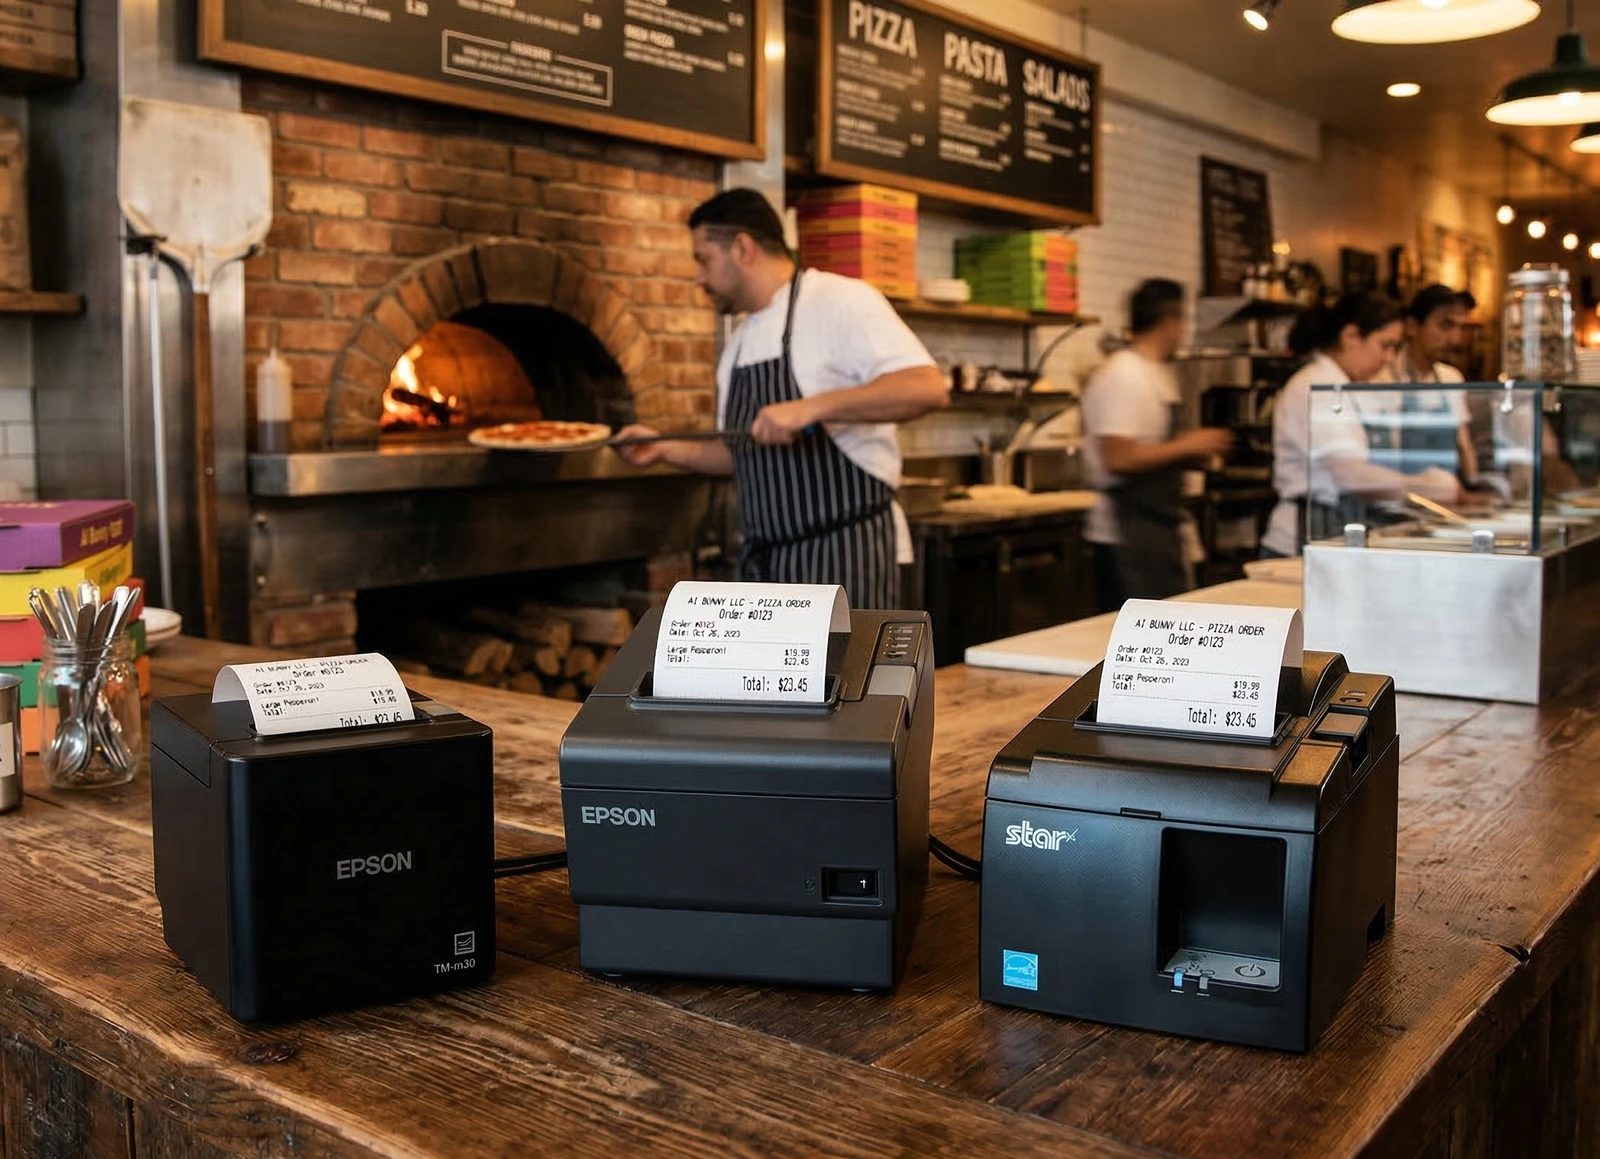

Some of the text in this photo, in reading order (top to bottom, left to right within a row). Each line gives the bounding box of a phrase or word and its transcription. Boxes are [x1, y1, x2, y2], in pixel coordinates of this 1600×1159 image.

[849, 1, 918, 59] PIZZA
[943, 31, 1009, 87] PASTA
[1022, 59, 1092, 113] SALADS
[701, 597, 726, 606] BUNNY
[729, 598, 746, 607] LLC
[757, 598, 782, 608] PIZZA
[785, 599, 811, 608] ORDER
[718, 608, 773, 621] Order #0123
[1135, 619, 1146, 629] AI
[1149, 619, 1176, 630] BUNNY
[1178, 621, 1195, 632] LLC
[1207, 622, 1234, 634] PIZZA
[1238, 625, 1265, 636] ORDER
[1168, 633, 1224, 649] Order #0123
[1117, 645, 1164, 656] Order #0123
[1139, 655, 1152, 664] Oct
[1172, 657, 1190, 667] 2023
[742, 676, 808, 693] Total: $23.45
[1233, 680, 1261, 690] $19.99
[1232, 690, 1259, 701] $23.45
[1187, 707, 1257, 728] Total: $23.45
[581, 805, 656, 827] EPSON
[1005, 820, 1068, 851] star
[336, 850, 412, 880] EPSON
[434, 958, 476, 974] TM-m30
